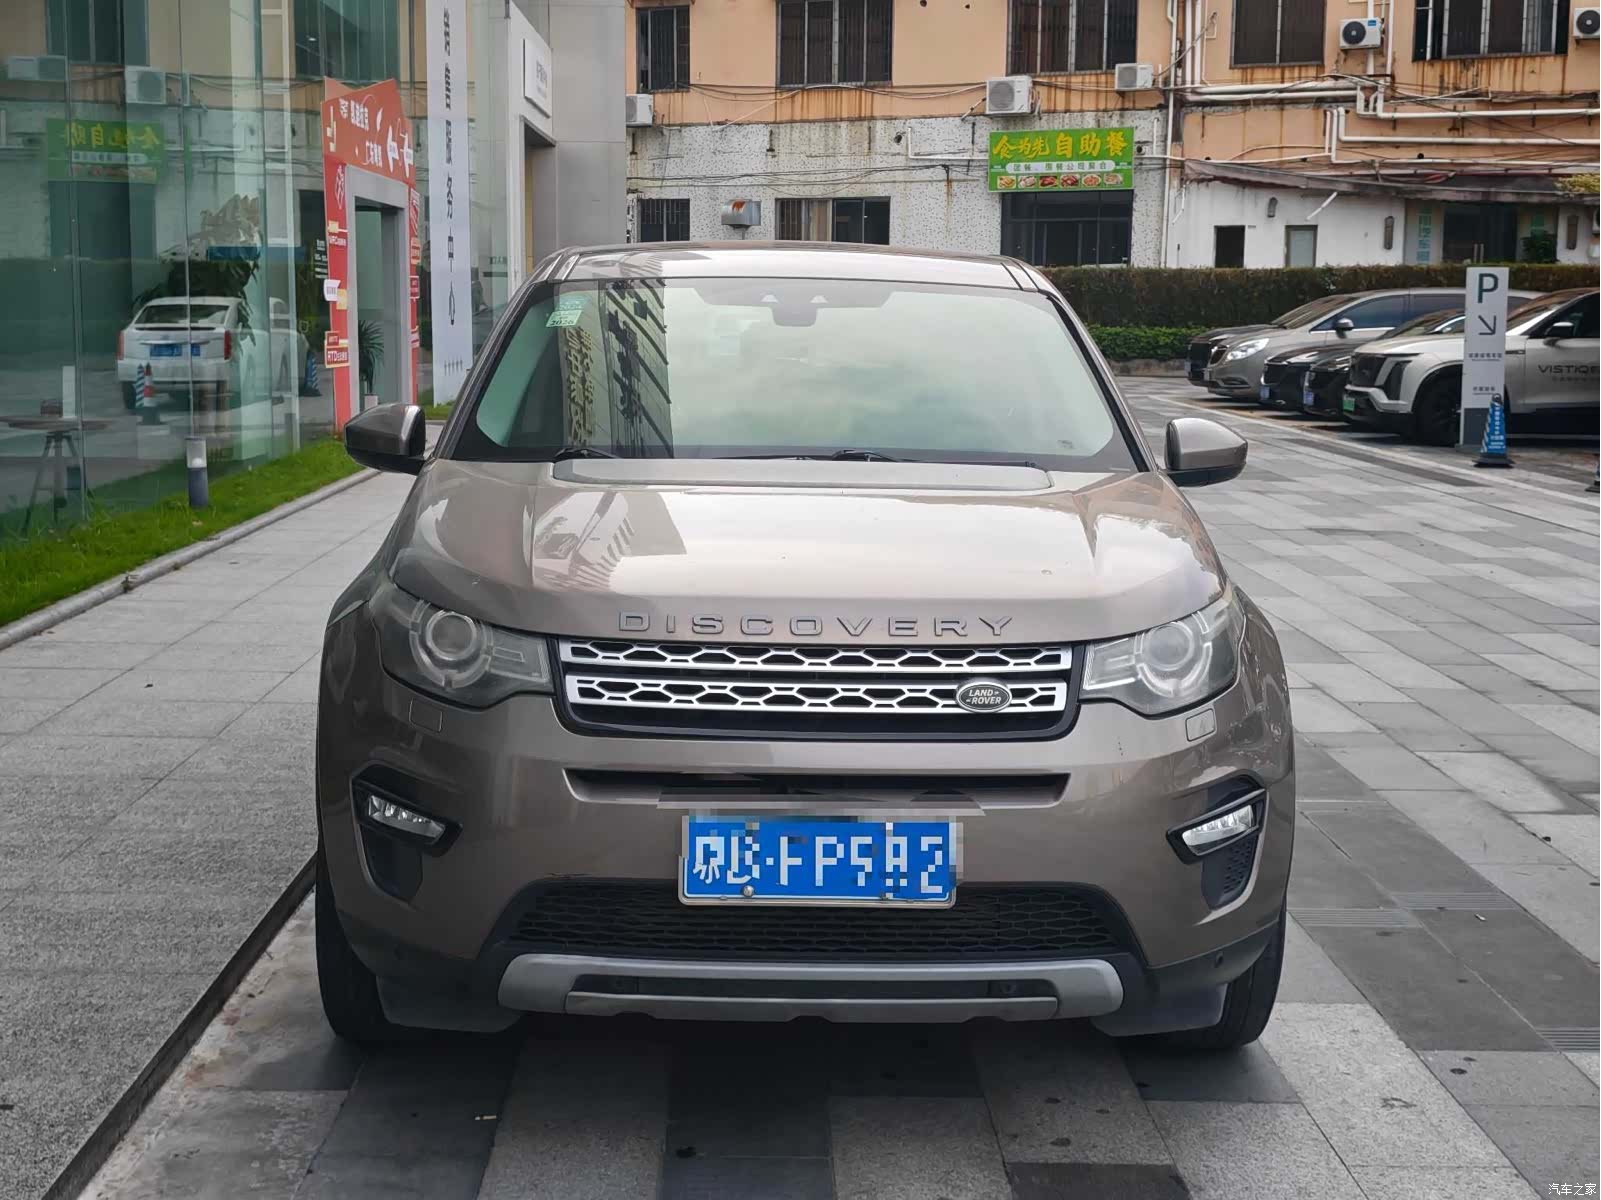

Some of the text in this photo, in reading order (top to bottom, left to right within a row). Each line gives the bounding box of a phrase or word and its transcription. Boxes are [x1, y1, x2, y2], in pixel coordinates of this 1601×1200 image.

[1477, 273, 1499, 304] P
[618, 611, 1013, 637] DISCOVERY
[968, 689, 994, 697] LAND
[971, 696, 1002, 705] ROVER
